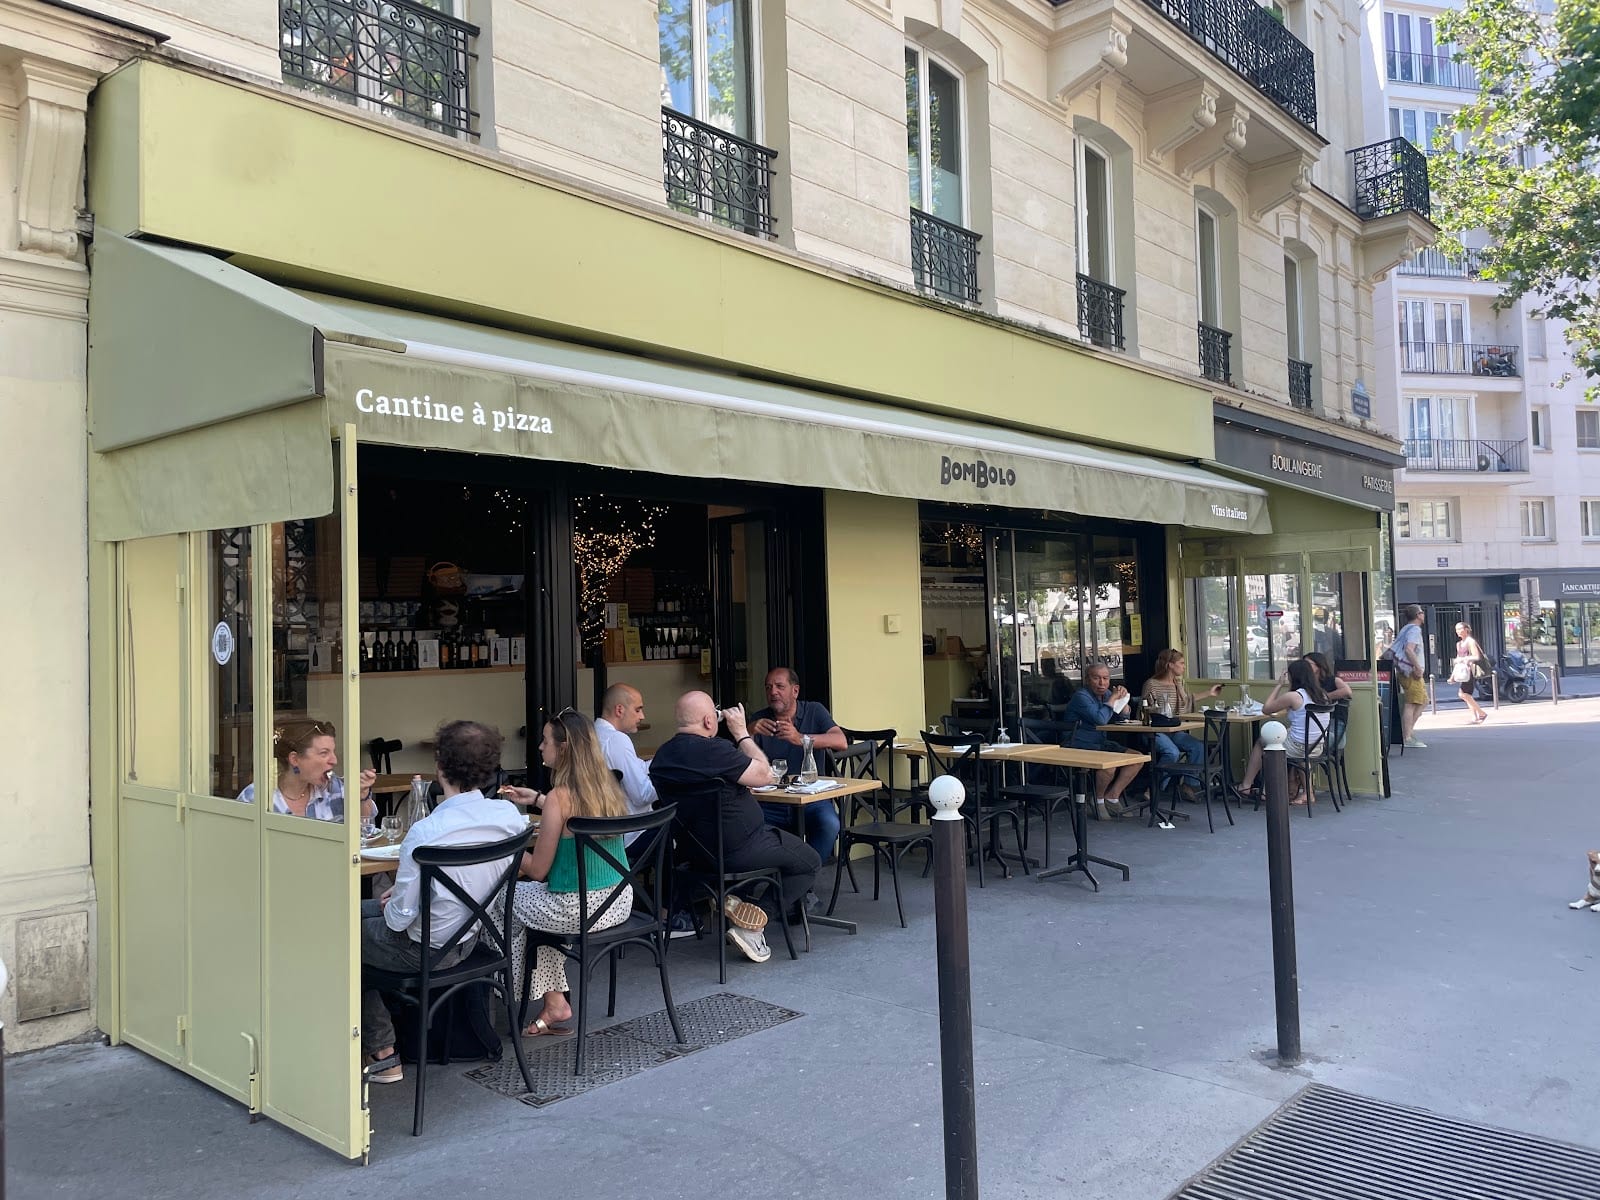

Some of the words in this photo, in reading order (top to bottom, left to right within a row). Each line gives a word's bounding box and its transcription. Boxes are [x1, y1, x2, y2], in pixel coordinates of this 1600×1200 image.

[355, 388, 464, 423] Cantine
[472, 401, 487, 426] à
[491, 406, 553, 434] pizza
[1271, 454, 1323, 479] BOULANGERIE
[1362, 475, 1393, 494] PATISSERIE
[1211, 504, 1226, 517] Vins
[1225, 506, 1248, 520] italiens
